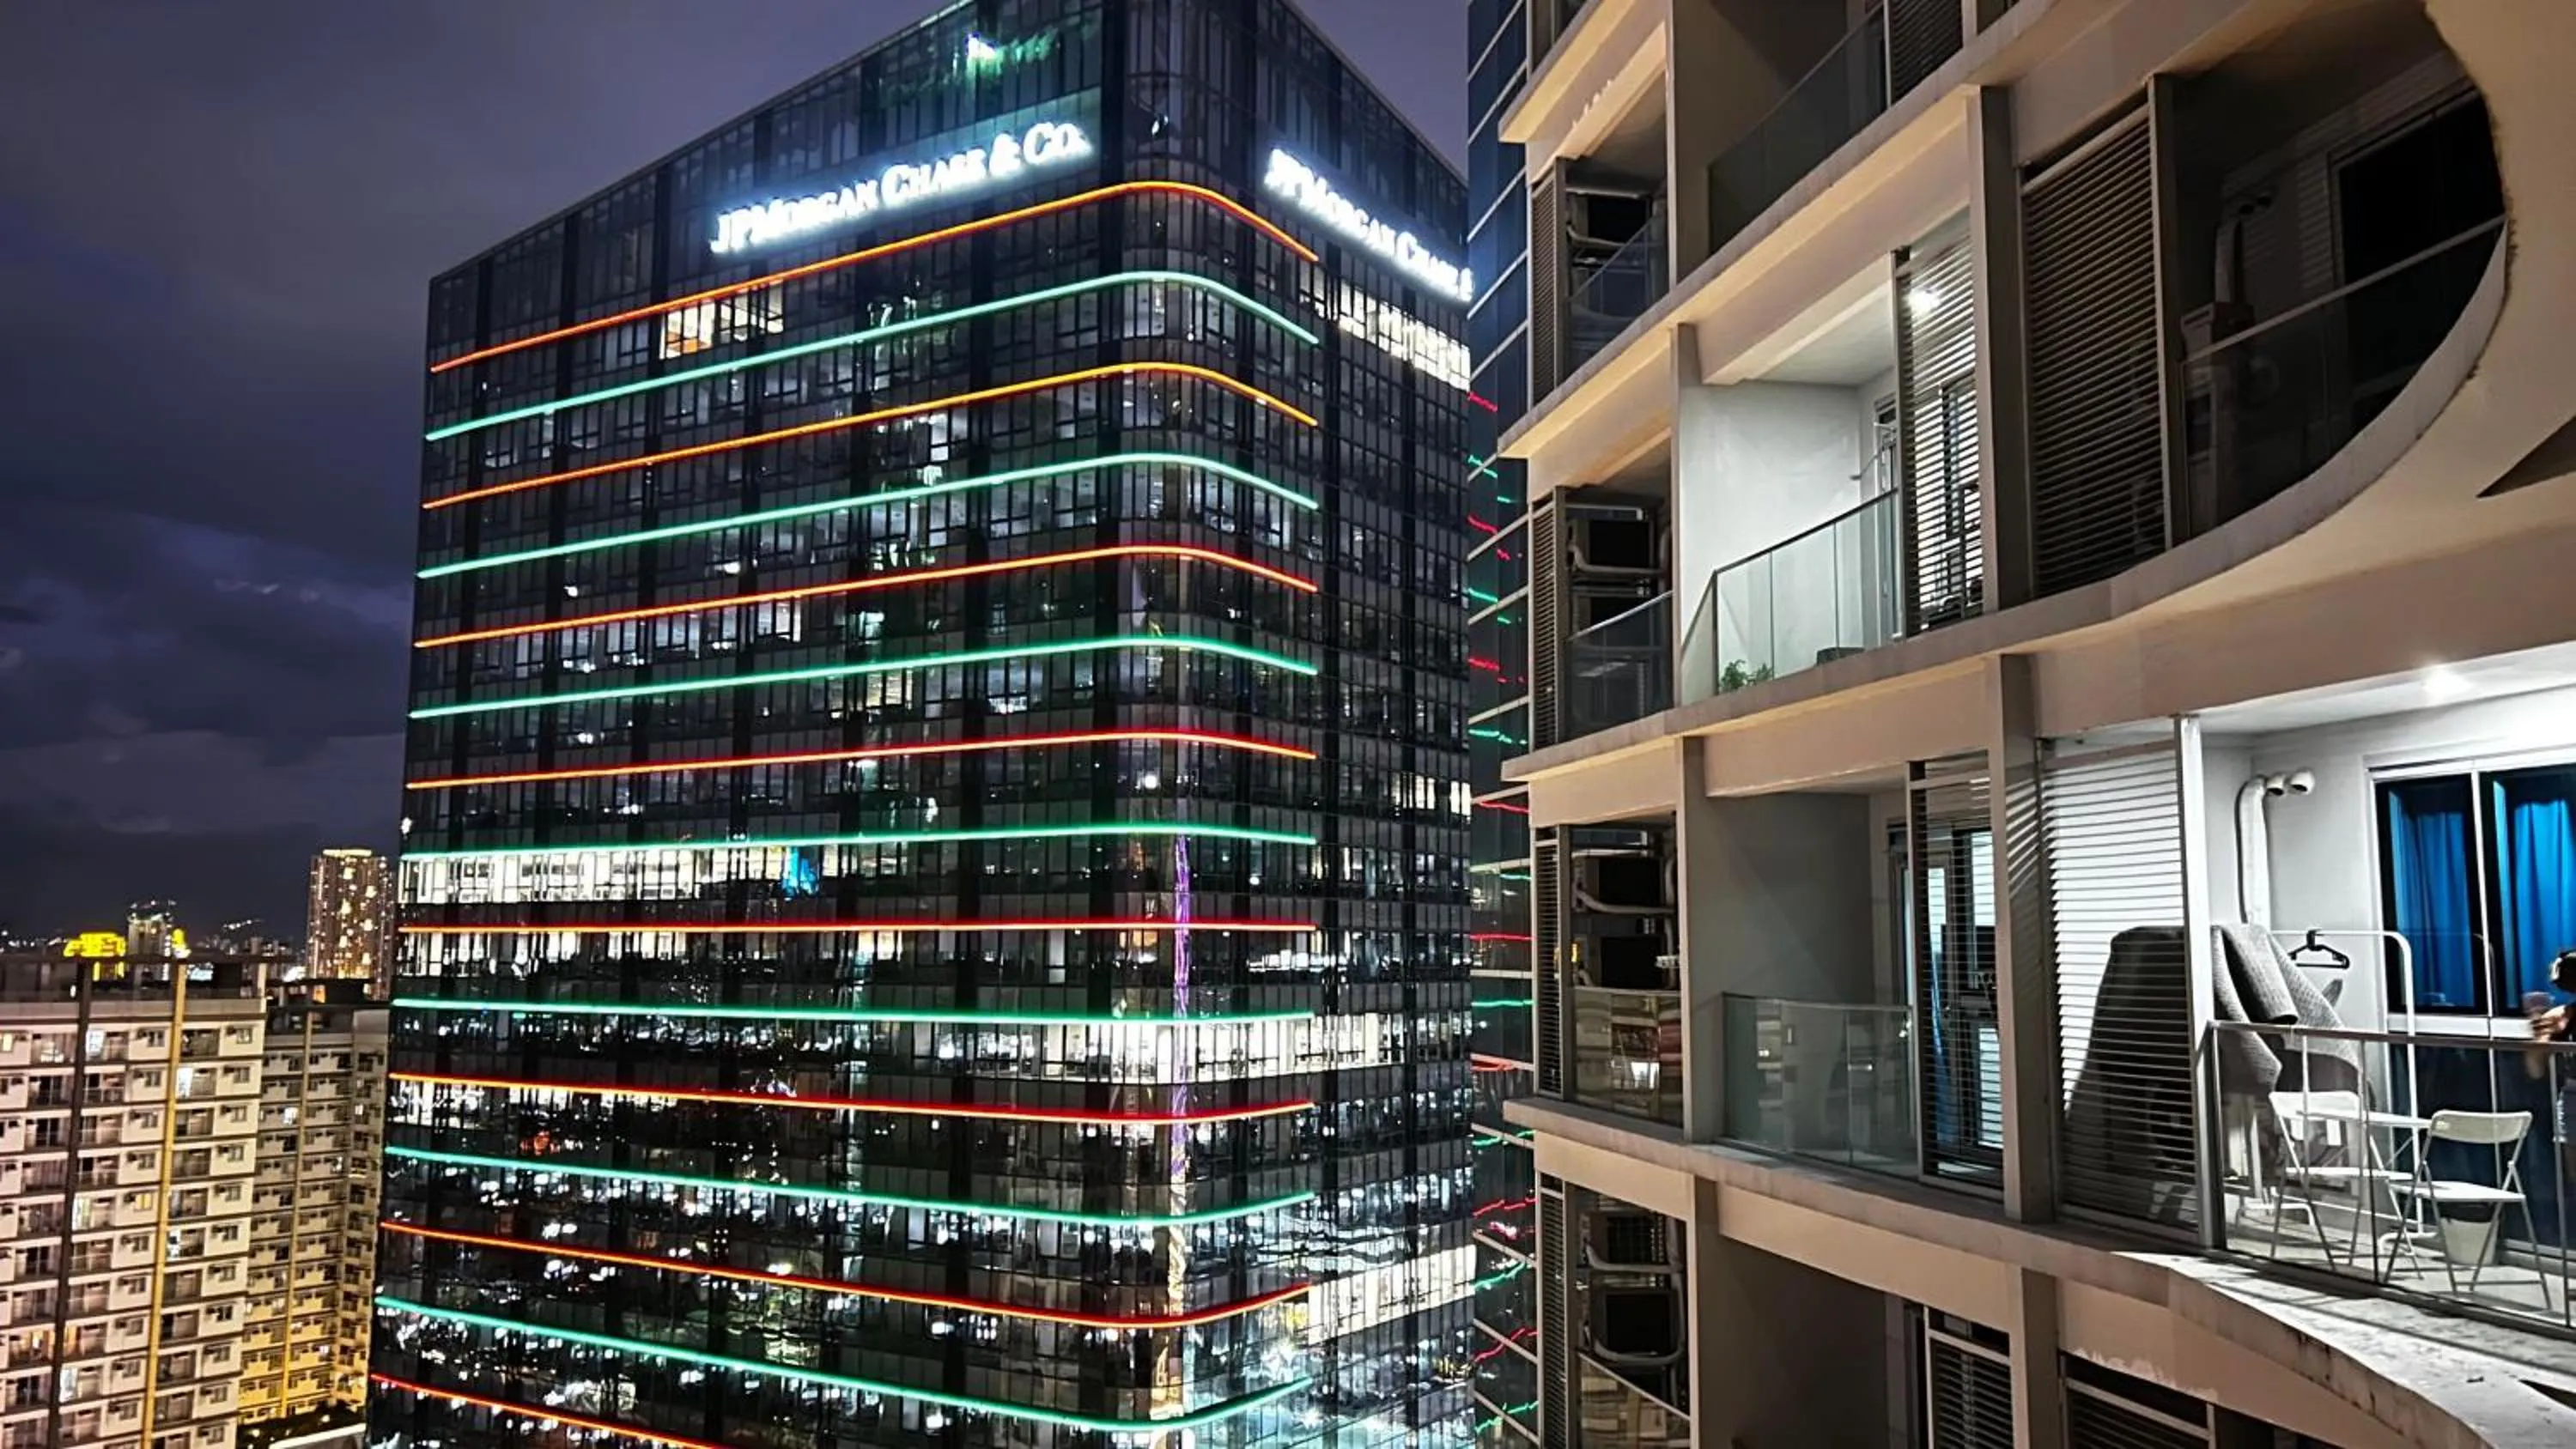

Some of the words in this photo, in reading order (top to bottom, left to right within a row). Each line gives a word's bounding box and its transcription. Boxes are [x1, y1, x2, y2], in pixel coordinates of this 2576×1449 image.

[712, 181, 879, 252] JPMORGAN
[882, 149, 987, 208] CHASE
[989, 133, 1023, 178] &
